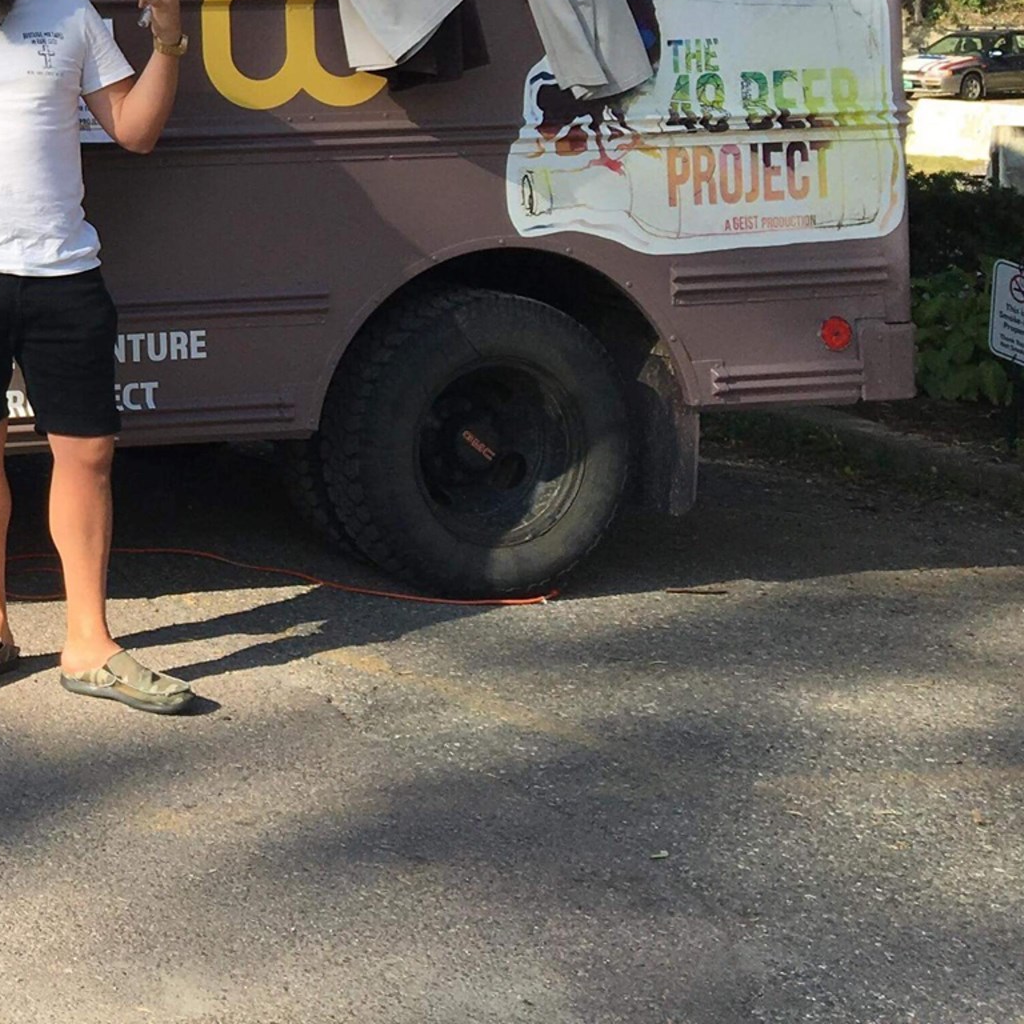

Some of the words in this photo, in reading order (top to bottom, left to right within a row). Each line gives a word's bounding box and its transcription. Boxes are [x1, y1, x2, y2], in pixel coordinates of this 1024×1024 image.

[667, 38, 720, 73] THE
[667, 141, 834, 207] PROJECT
[724, 219, 732, 231] A
[733, 216, 758, 230] GEIST
[761, 215, 817, 229] PRODUCTION
